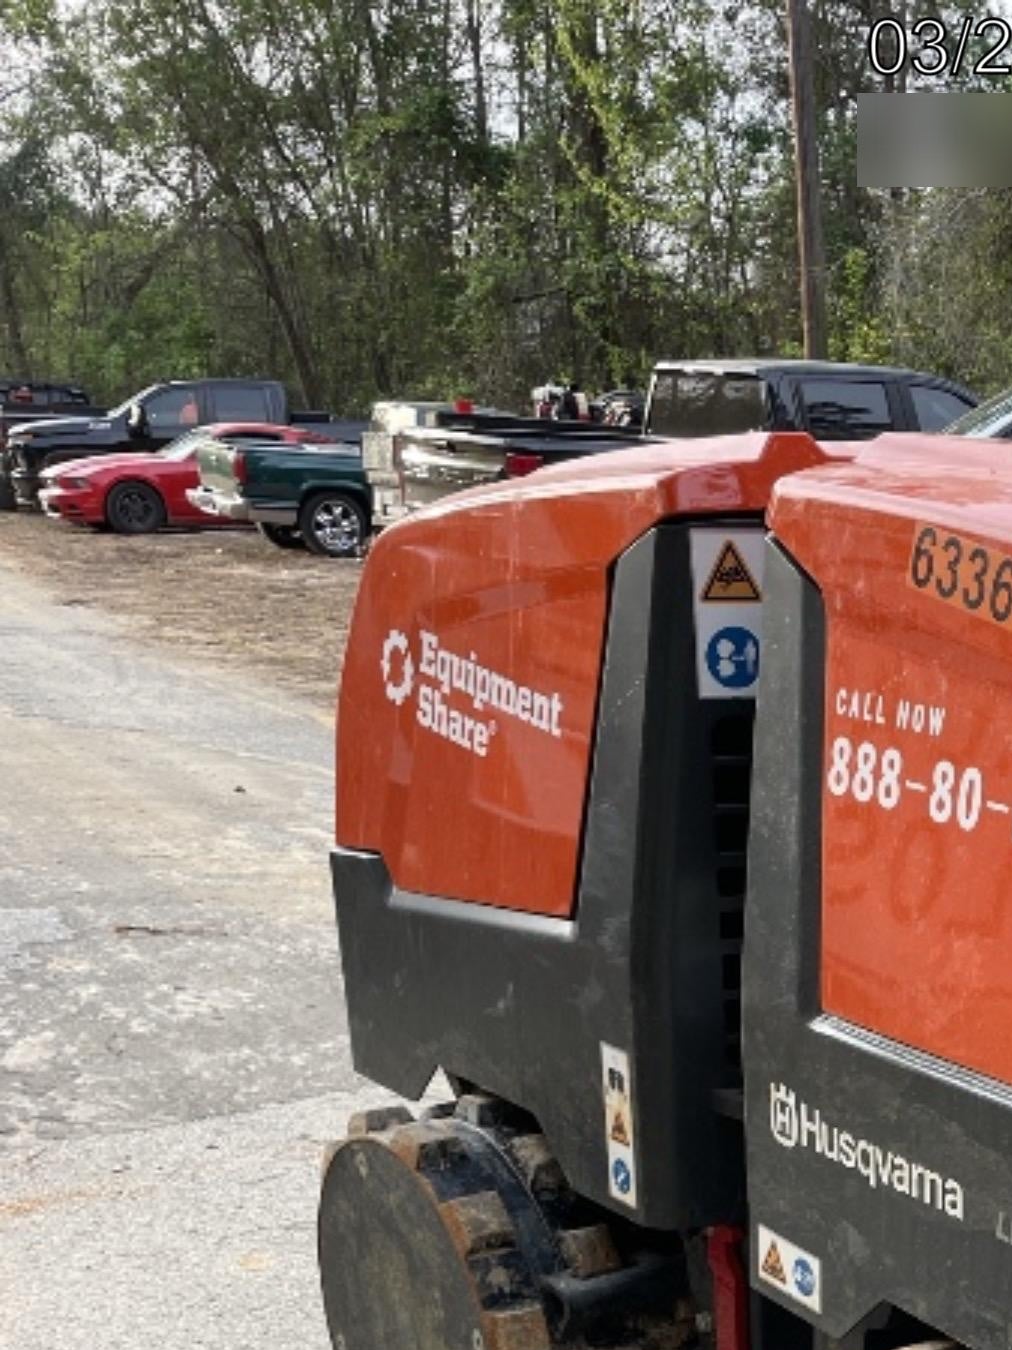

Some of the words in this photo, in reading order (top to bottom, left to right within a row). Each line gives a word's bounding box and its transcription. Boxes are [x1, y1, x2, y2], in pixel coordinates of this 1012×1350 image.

[418, 629, 563, 738] Equipment
[836, 688, 886, 724] CALL
[896, 699, 946, 736] NOW
[800, 1102, 965, 1221] Husqvarna
